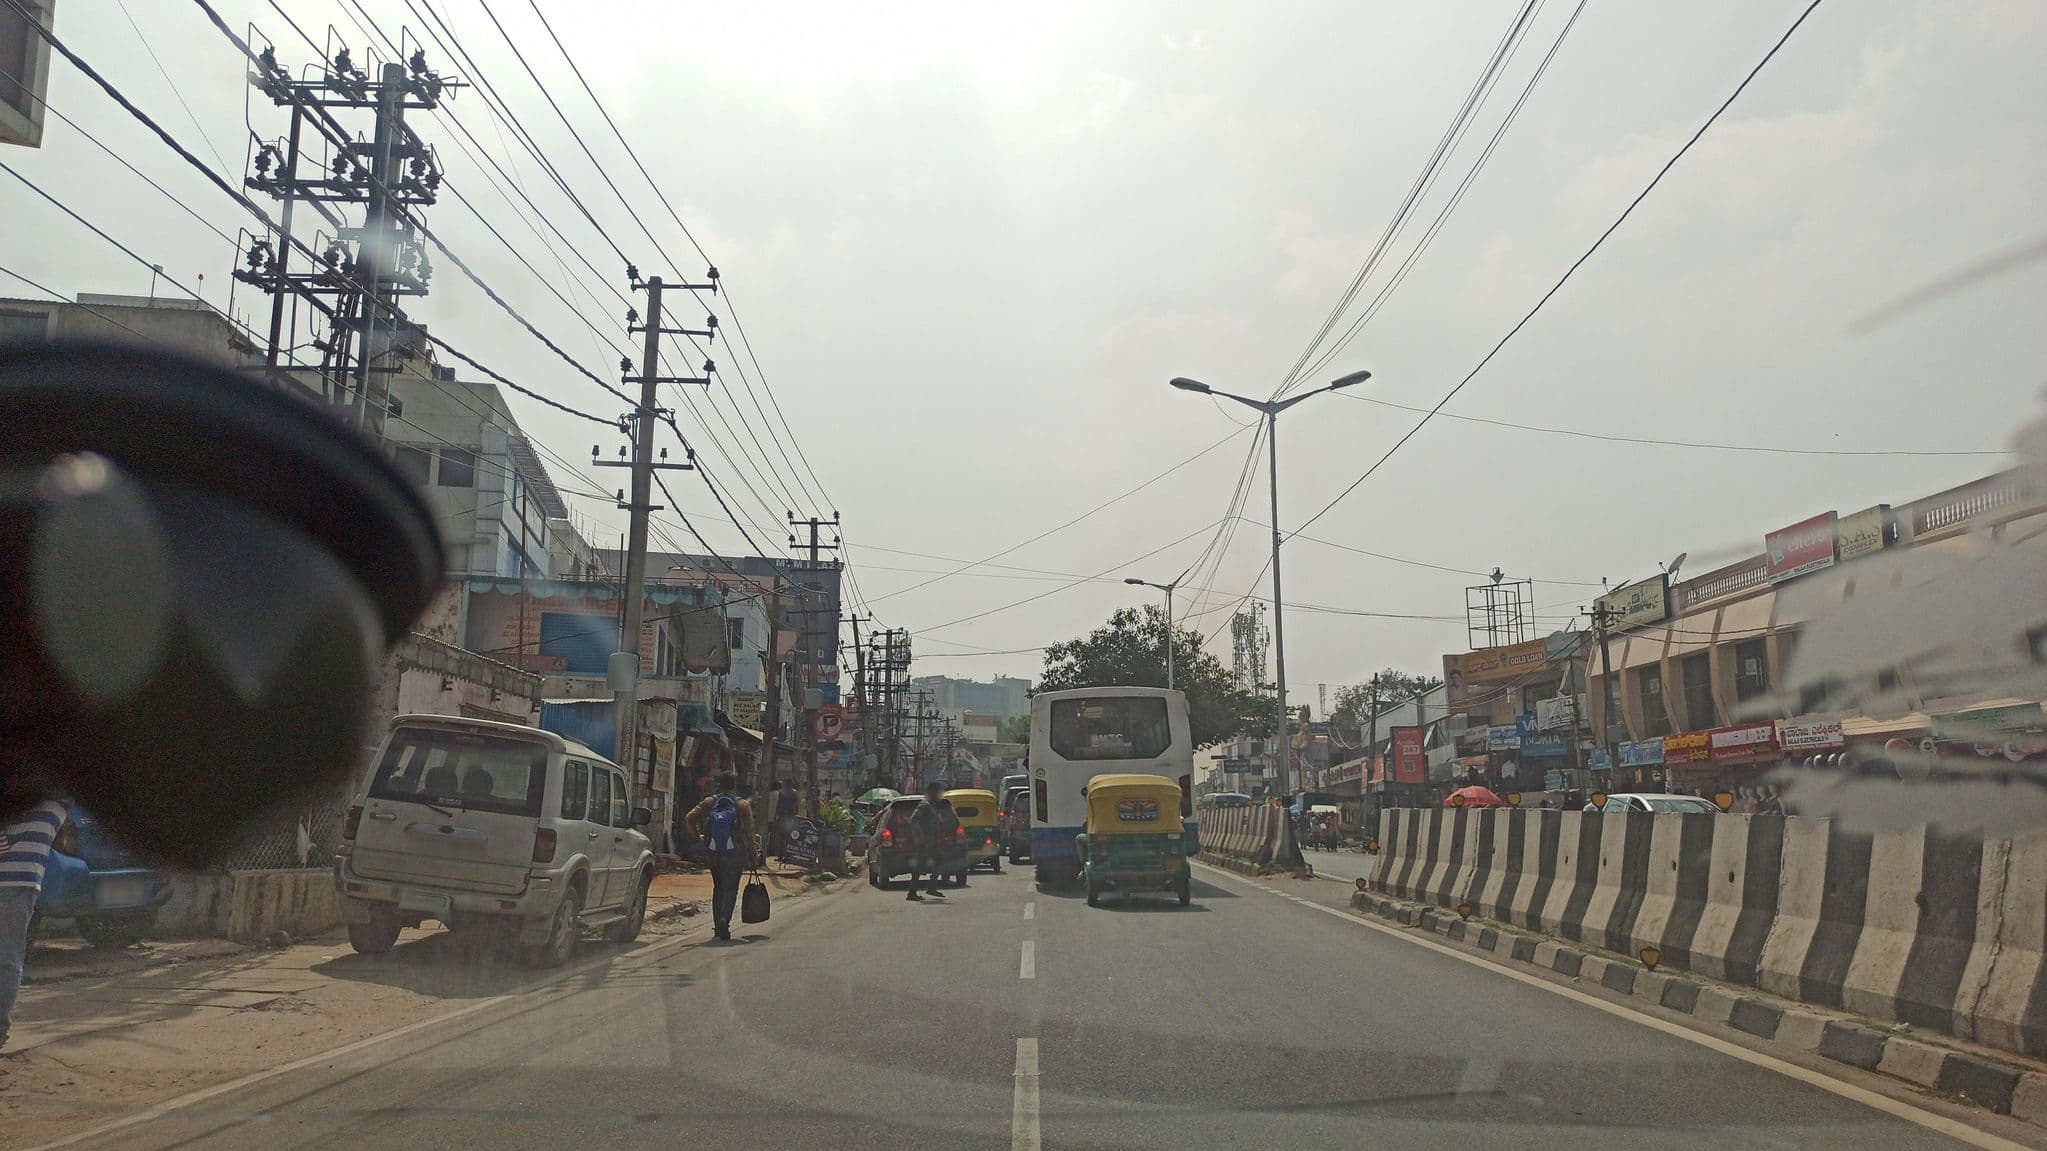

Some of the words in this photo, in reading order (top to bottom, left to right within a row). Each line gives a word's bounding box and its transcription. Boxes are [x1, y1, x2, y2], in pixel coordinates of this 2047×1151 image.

[1844, 538, 1879, 553] COMPLEX
[806, 561, 845, 571] PAZA
[1510, 655, 1526, 665] GOLD
[1527, 651, 1543, 662] LOAN
